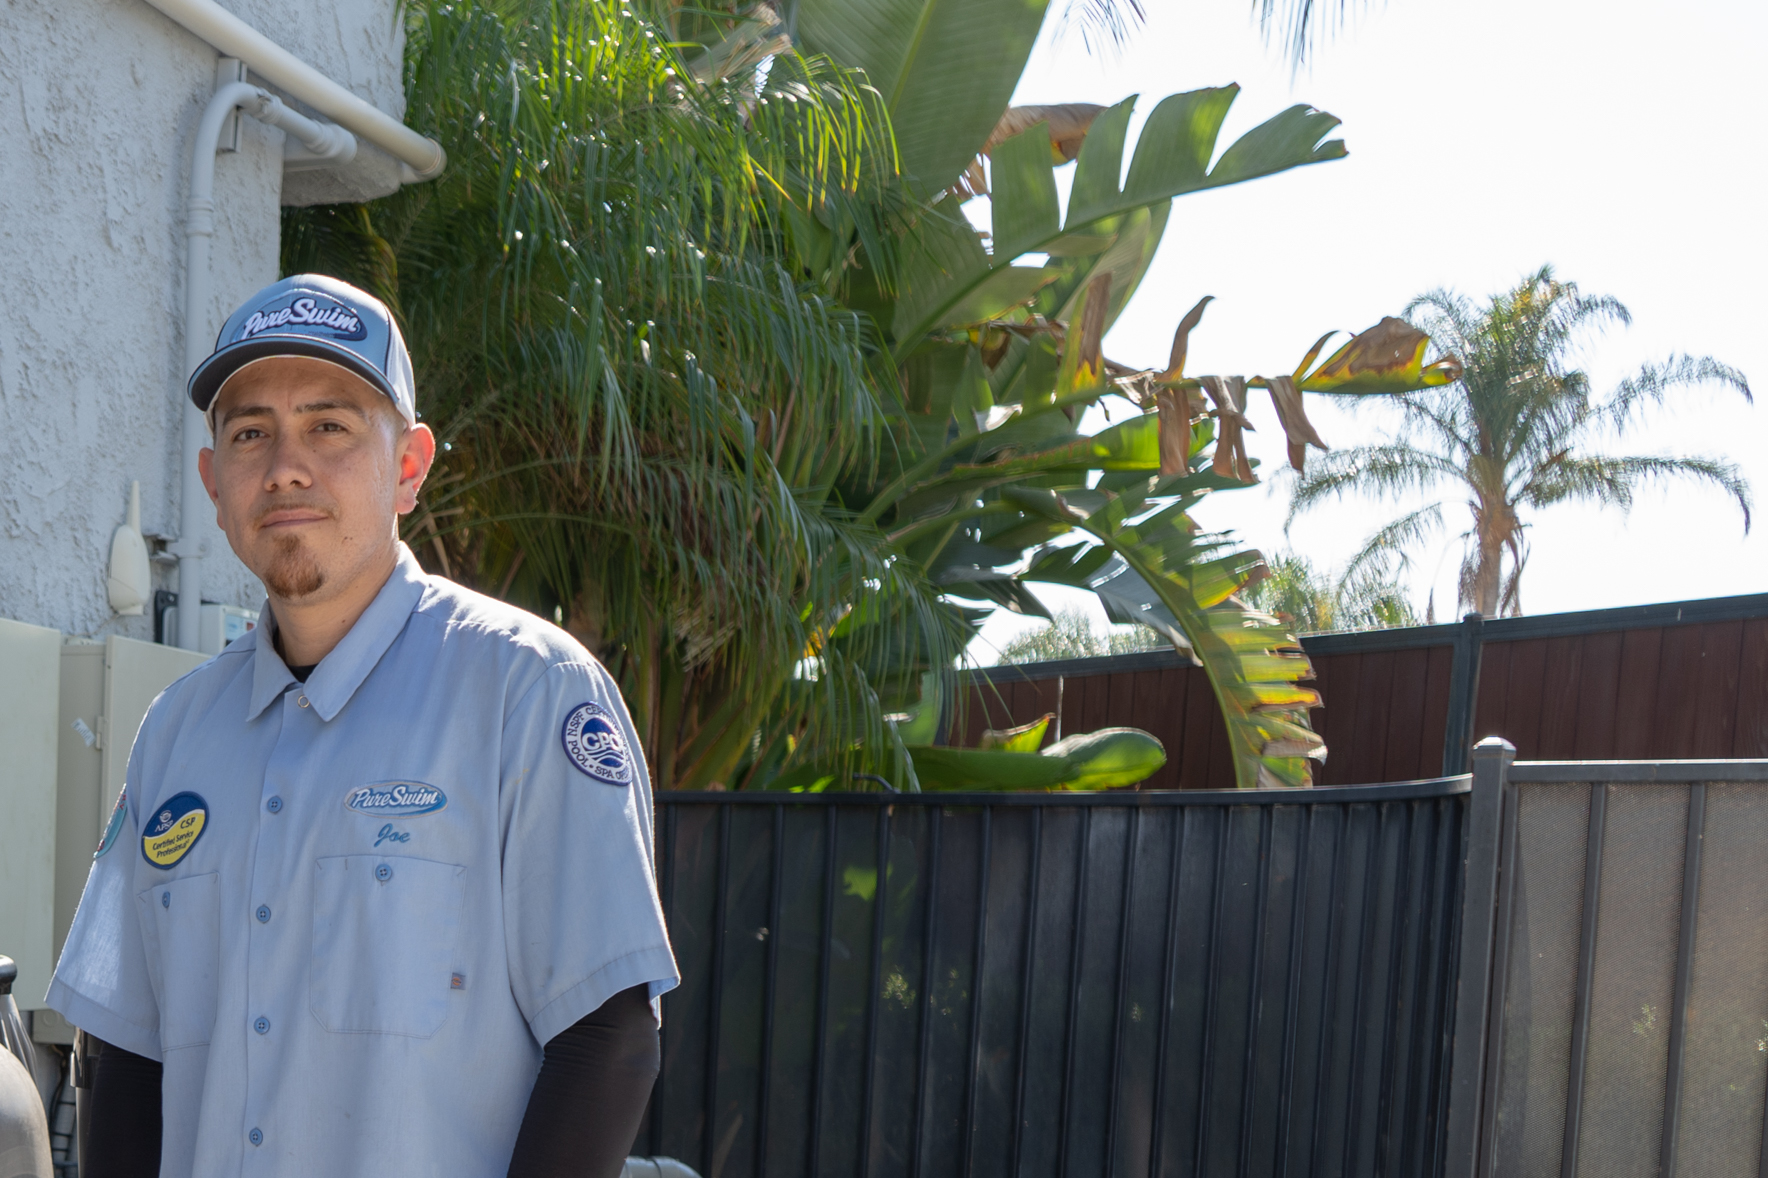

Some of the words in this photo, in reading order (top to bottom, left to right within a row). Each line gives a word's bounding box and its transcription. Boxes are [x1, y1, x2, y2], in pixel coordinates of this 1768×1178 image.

[241, 297, 359, 340] PureSwim
[568, 740, 588, 768] POOL
[595, 765, 615, 779] SPA
[351, 785, 439, 808] PureSwim
[180, 816, 197, 830] CSP
[152, 836, 176, 851] Certified
[176, 830, 195, 842] Service
[374, 823, 410, 847] Joe
